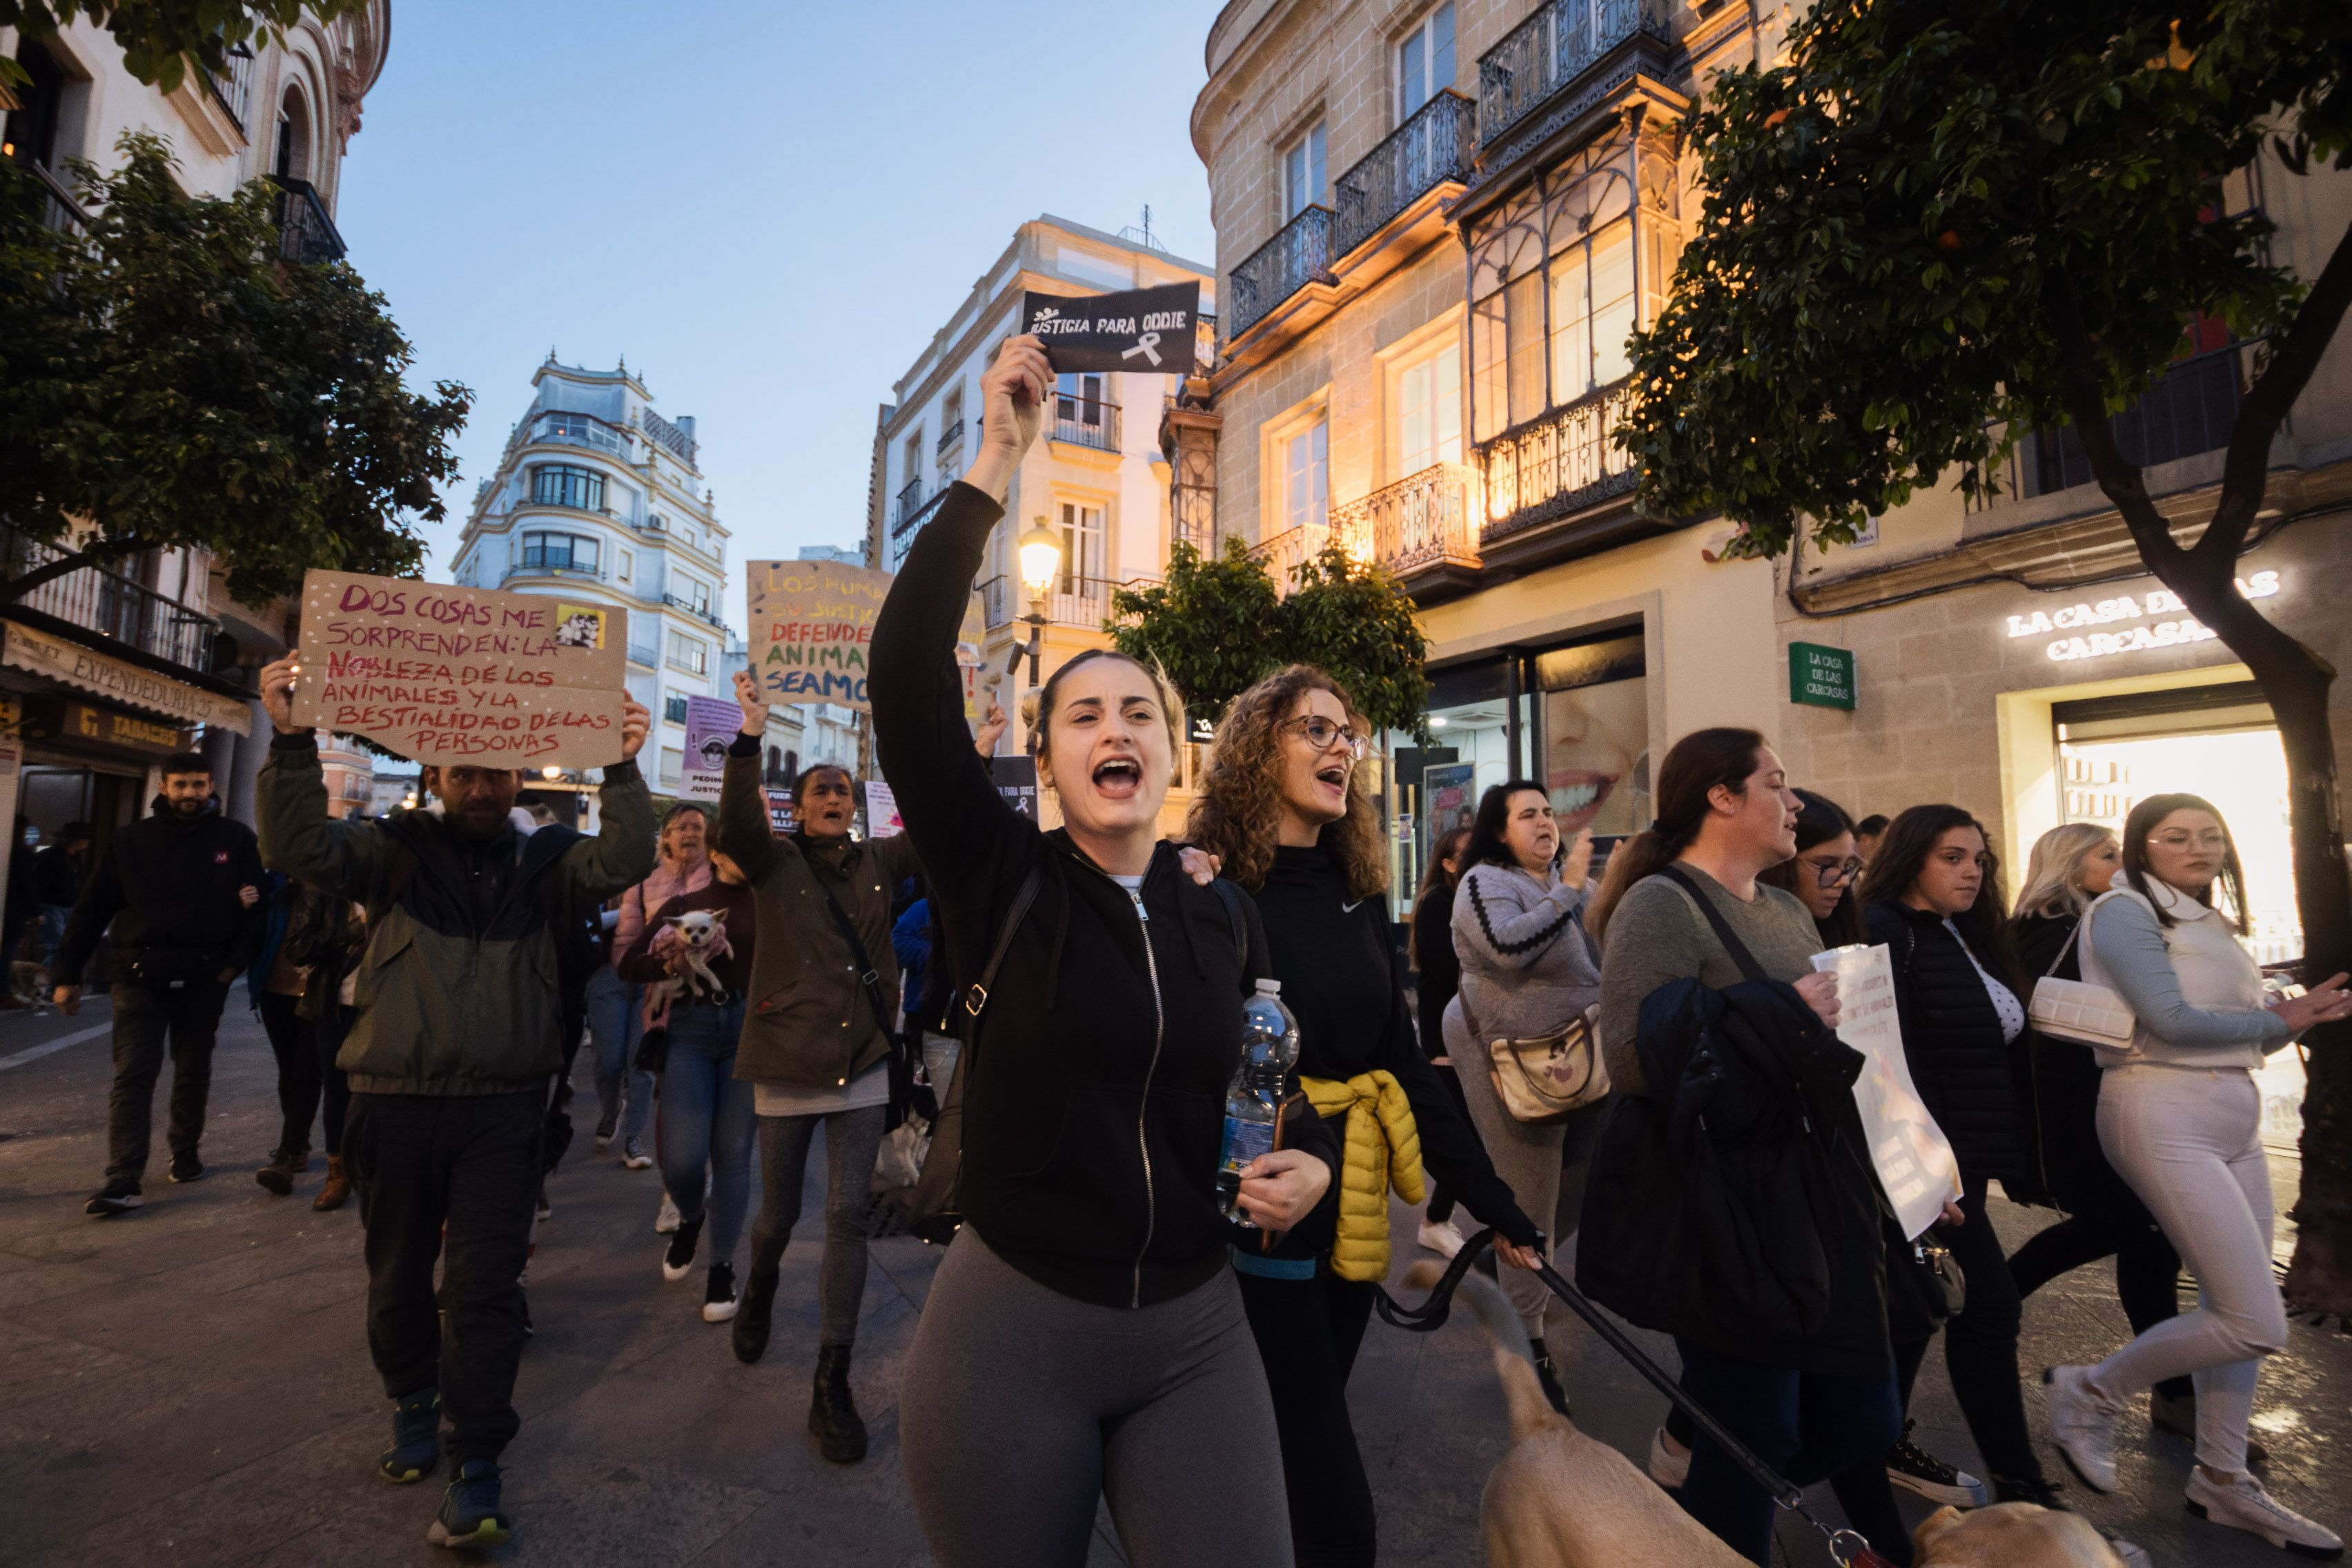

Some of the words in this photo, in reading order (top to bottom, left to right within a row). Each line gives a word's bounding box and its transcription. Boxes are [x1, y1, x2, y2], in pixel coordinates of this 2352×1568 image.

[1027, 318, 1090, 335] JUSTICIA
[1096, 317, 1136, 335] PARA
[1142, 311, 1186, 331] ODDIE
[767, 569, 818, 594] LOS
[339, 585, 406, 616] DOS
[415, 596, 492, 626] COSAS
[501, 609, 545, 629] ME
[2006, 611, 2054, 638] LA
[2053, 596, 2143, 629] CASA
[771, 622, 872, 643] DEFENDE
[522, 636, 558, 658] LA
[766, 643, 866, 672] ANIMA
[327, 650, 453, 685] NOBLEZA
[460, 664, 498, 686] DE
[504, 665, 554, 687] LOS
[1809, 652, 1821, 665] LA
[1822, 656, 1843, 669] CASA
[1812, 669, 1824, 680] DE
[1825, 671, 1842, 684] LAS
[321, 680, 460, 705] ANIMALES
[467, 688, 487, 708] Y
[489, 692, 518, 709] LA
[1807, 683, 1849, 700] CARCASAS
[404, 729, 560, 758] PERSONAS
[691, 785, 723, 794] JUSTIC
[767, 792, 792, 800] FUER
